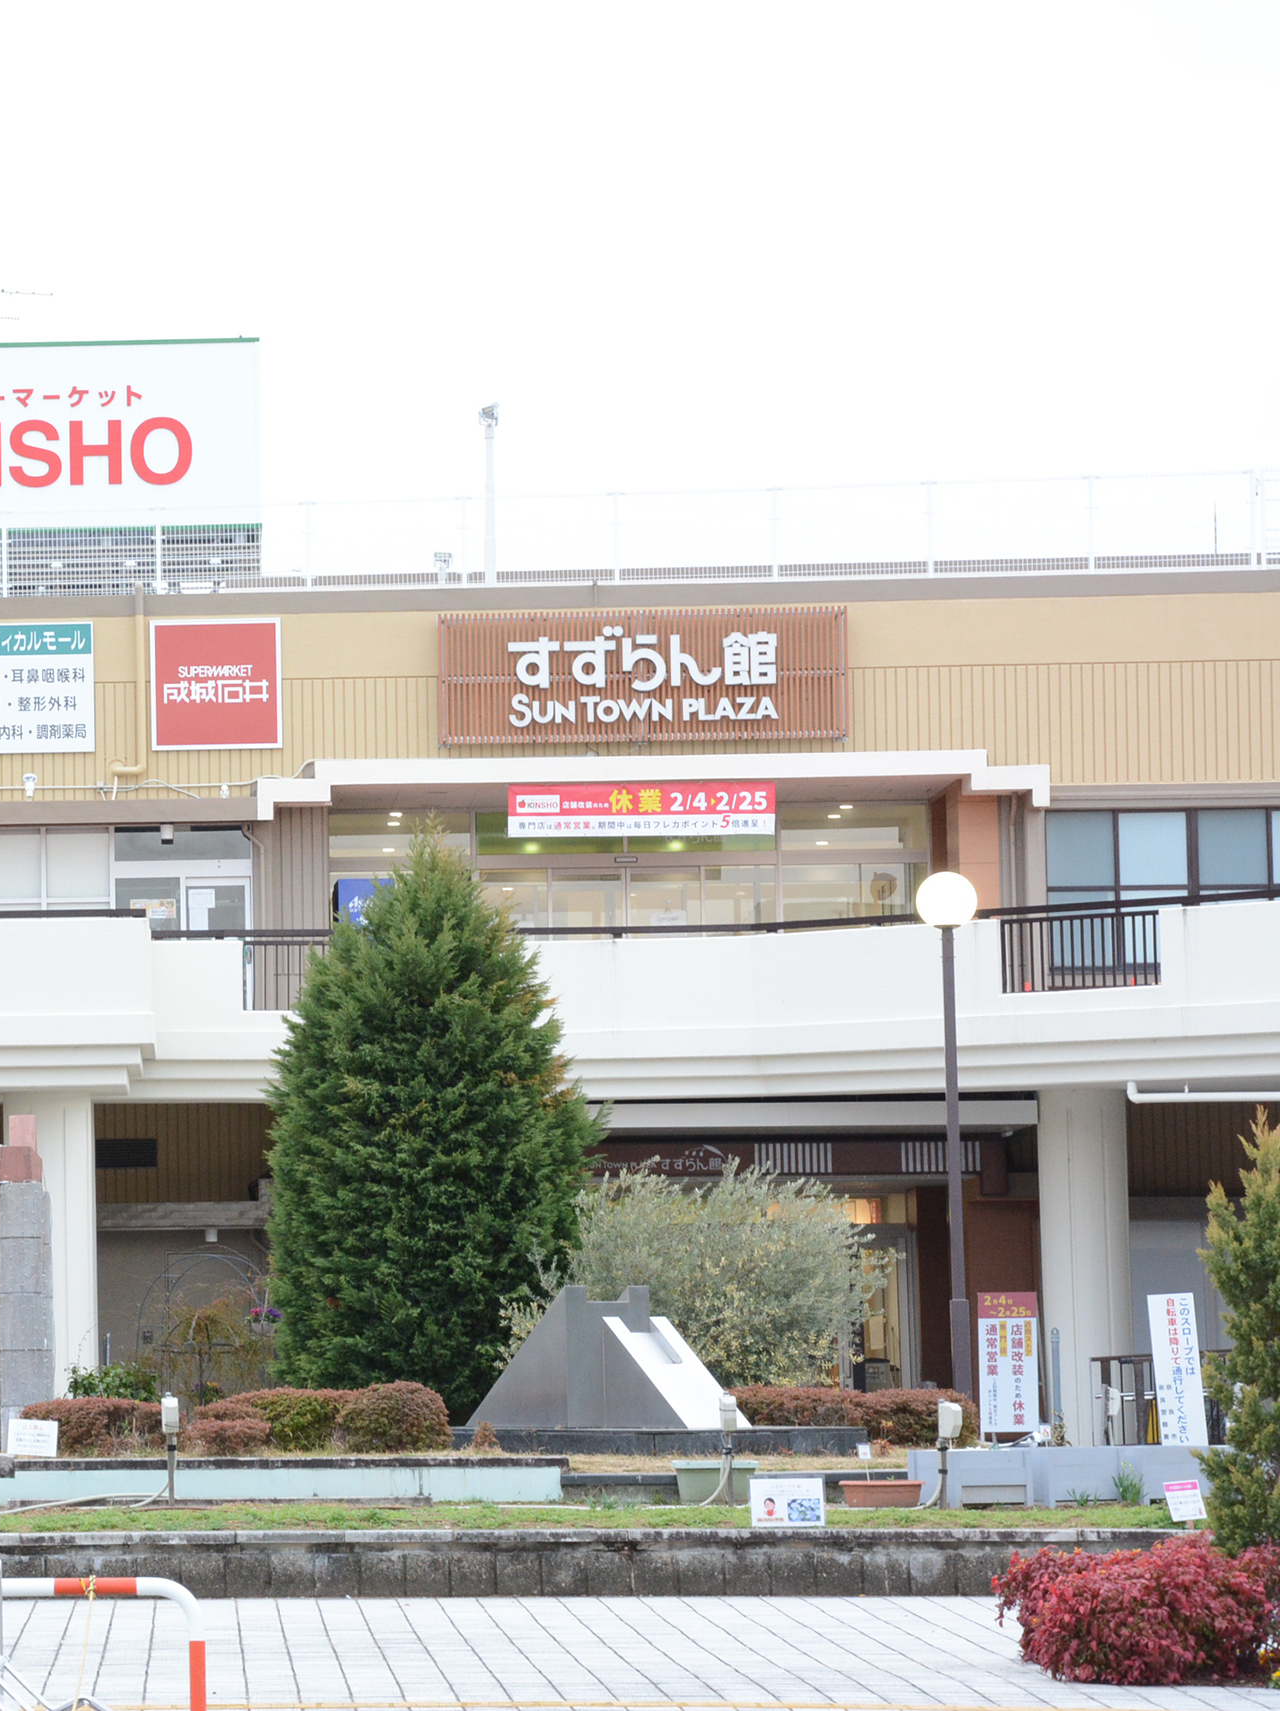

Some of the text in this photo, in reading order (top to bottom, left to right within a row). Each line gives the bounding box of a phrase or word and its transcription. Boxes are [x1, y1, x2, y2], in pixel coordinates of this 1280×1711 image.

[178, 665, 253, 678] SUPERMARKET
[507, 625, 778, 691] すずらん館
[163, 679, 269, 704] 成城石井
[508, 693, 779, 728] SUN TOWN PLAZA
[526, 801, 559, 809] KINSHO
[562, 788, 767, 814] 店舗改装のため 休業 2/4 2/25
[660, 1156, 722, 1172] すずらん館
[983, 1295, 1013, 1305] 2月4日
[985, 1324, 998, 1376] 通常営業
[1179, 1298, 1196, 1376] このスロープでは
[1011, 1324, 1025, 1426] 店舗改装のため休業
[1166, 1297, 1190, 1444] 自転車は降りて通行してください
